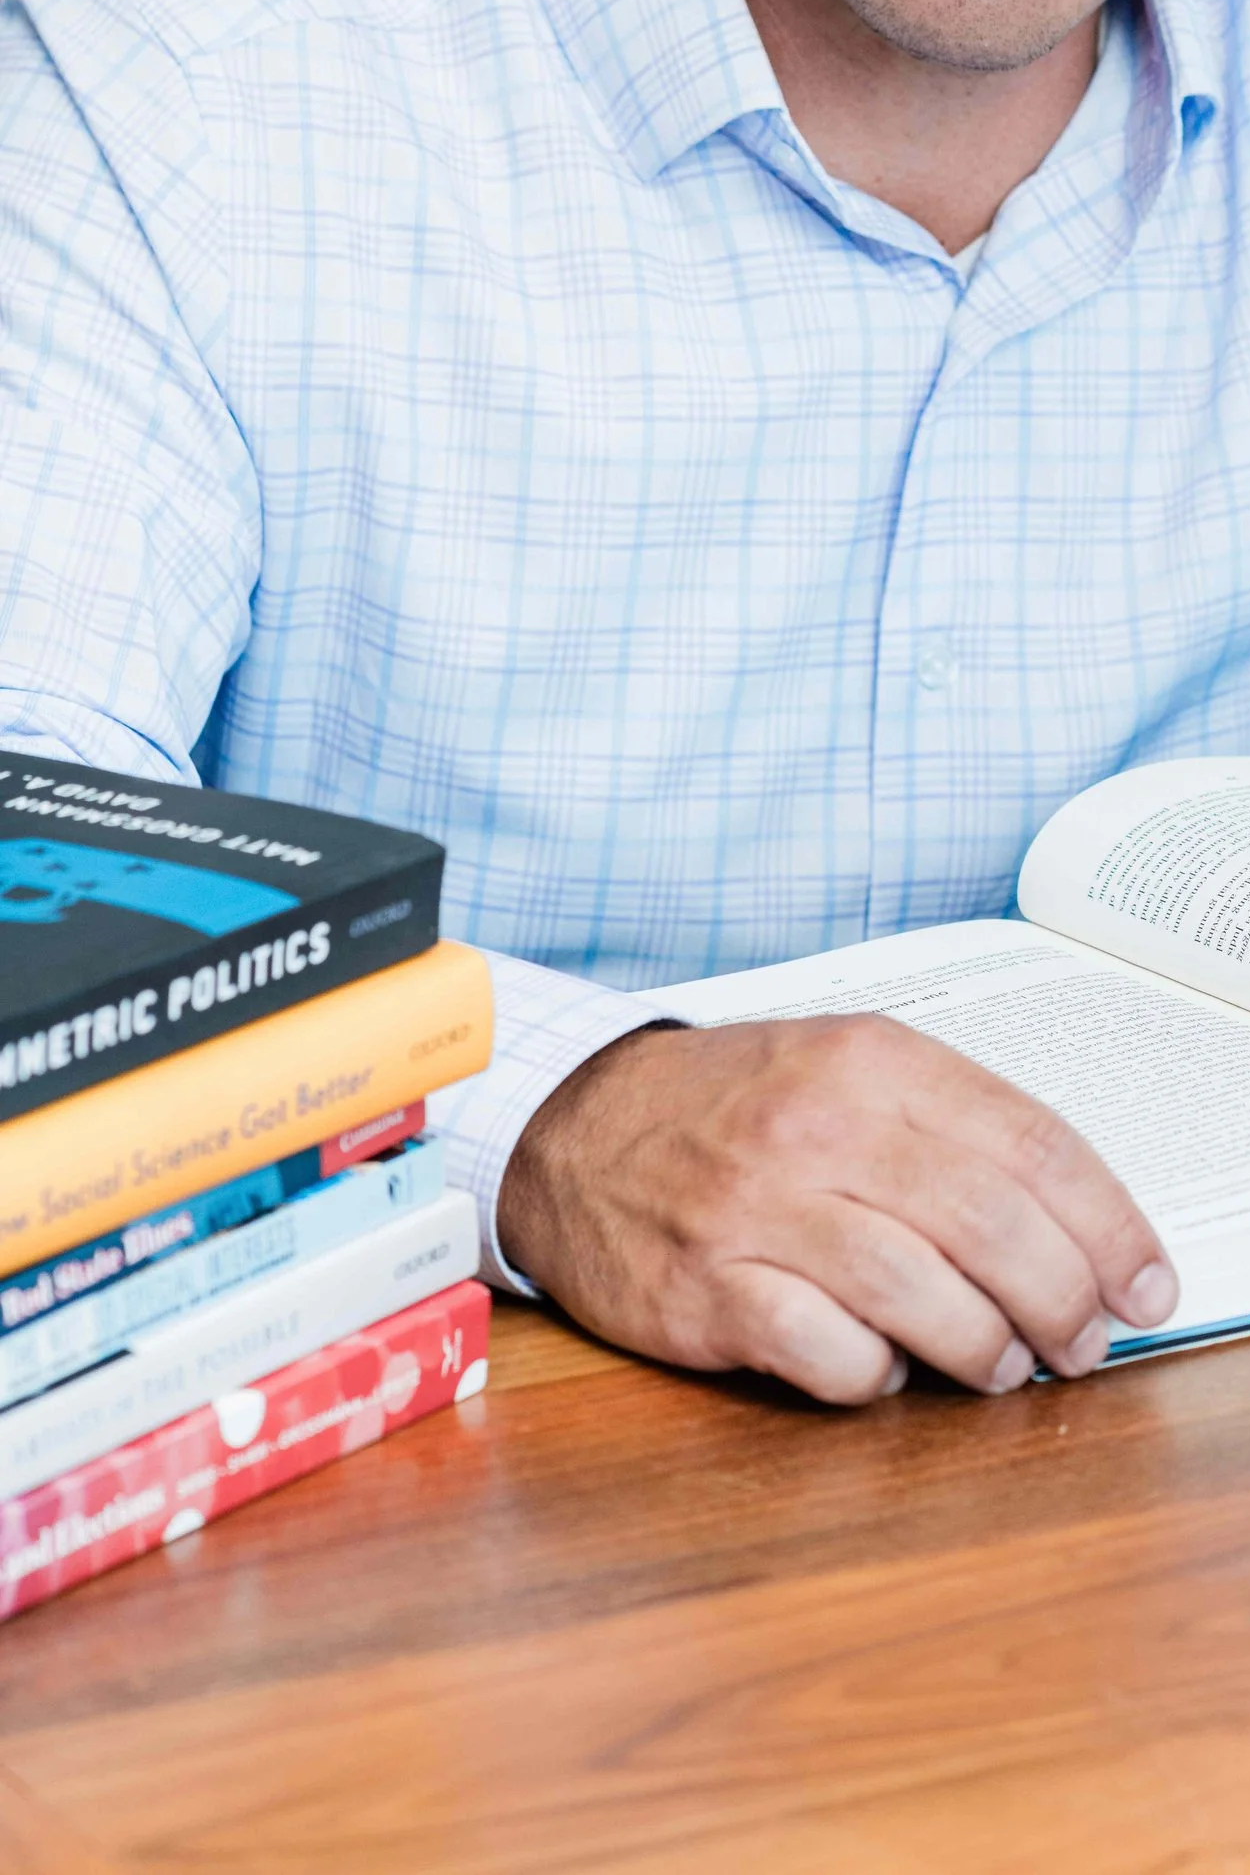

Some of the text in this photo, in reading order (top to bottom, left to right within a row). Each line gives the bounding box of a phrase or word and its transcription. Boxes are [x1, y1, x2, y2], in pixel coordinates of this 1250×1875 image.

[22, 774, 161, 812] DAVID A.
[5, 796, 321, 866] MATT GROSSMANN
[1096, 842, 1123, 880] decline
[1151, 850, 1174, 874] other
[1172, 871, 1185, 882] by
[1086, 886, 1094, 899] of
[1108, 895, 1115, 907] of
[1120, 873, 1138, 911] argues
[1136, 879, 1150, 900] side
[1173, 858, 1226, 933] and consultant
[1217, 867, 1248, 898] crucial
[1130, 903, 1136, 916] of
[1149, 886, 1172, 924] taking
[1195, 899, 1217, 943] ground
[1204, 894, 1236, 947] achieving
[1216, 919, 1232, 952] social
[167, 921, 331, 1022] POLITICS
[919, 991, 949, 1001] OUR
[39, 1164, 124, 1224] Social
[131, 1127, 230, 1186] Science
[239, 1100, 288, 1139] Got
[295, 1067, 374, 1116] Better
[0, 1273, 52, 1327] Red
[52, 1247, 126, 1300] State
[122, 1210, 195, 1266] Blues
